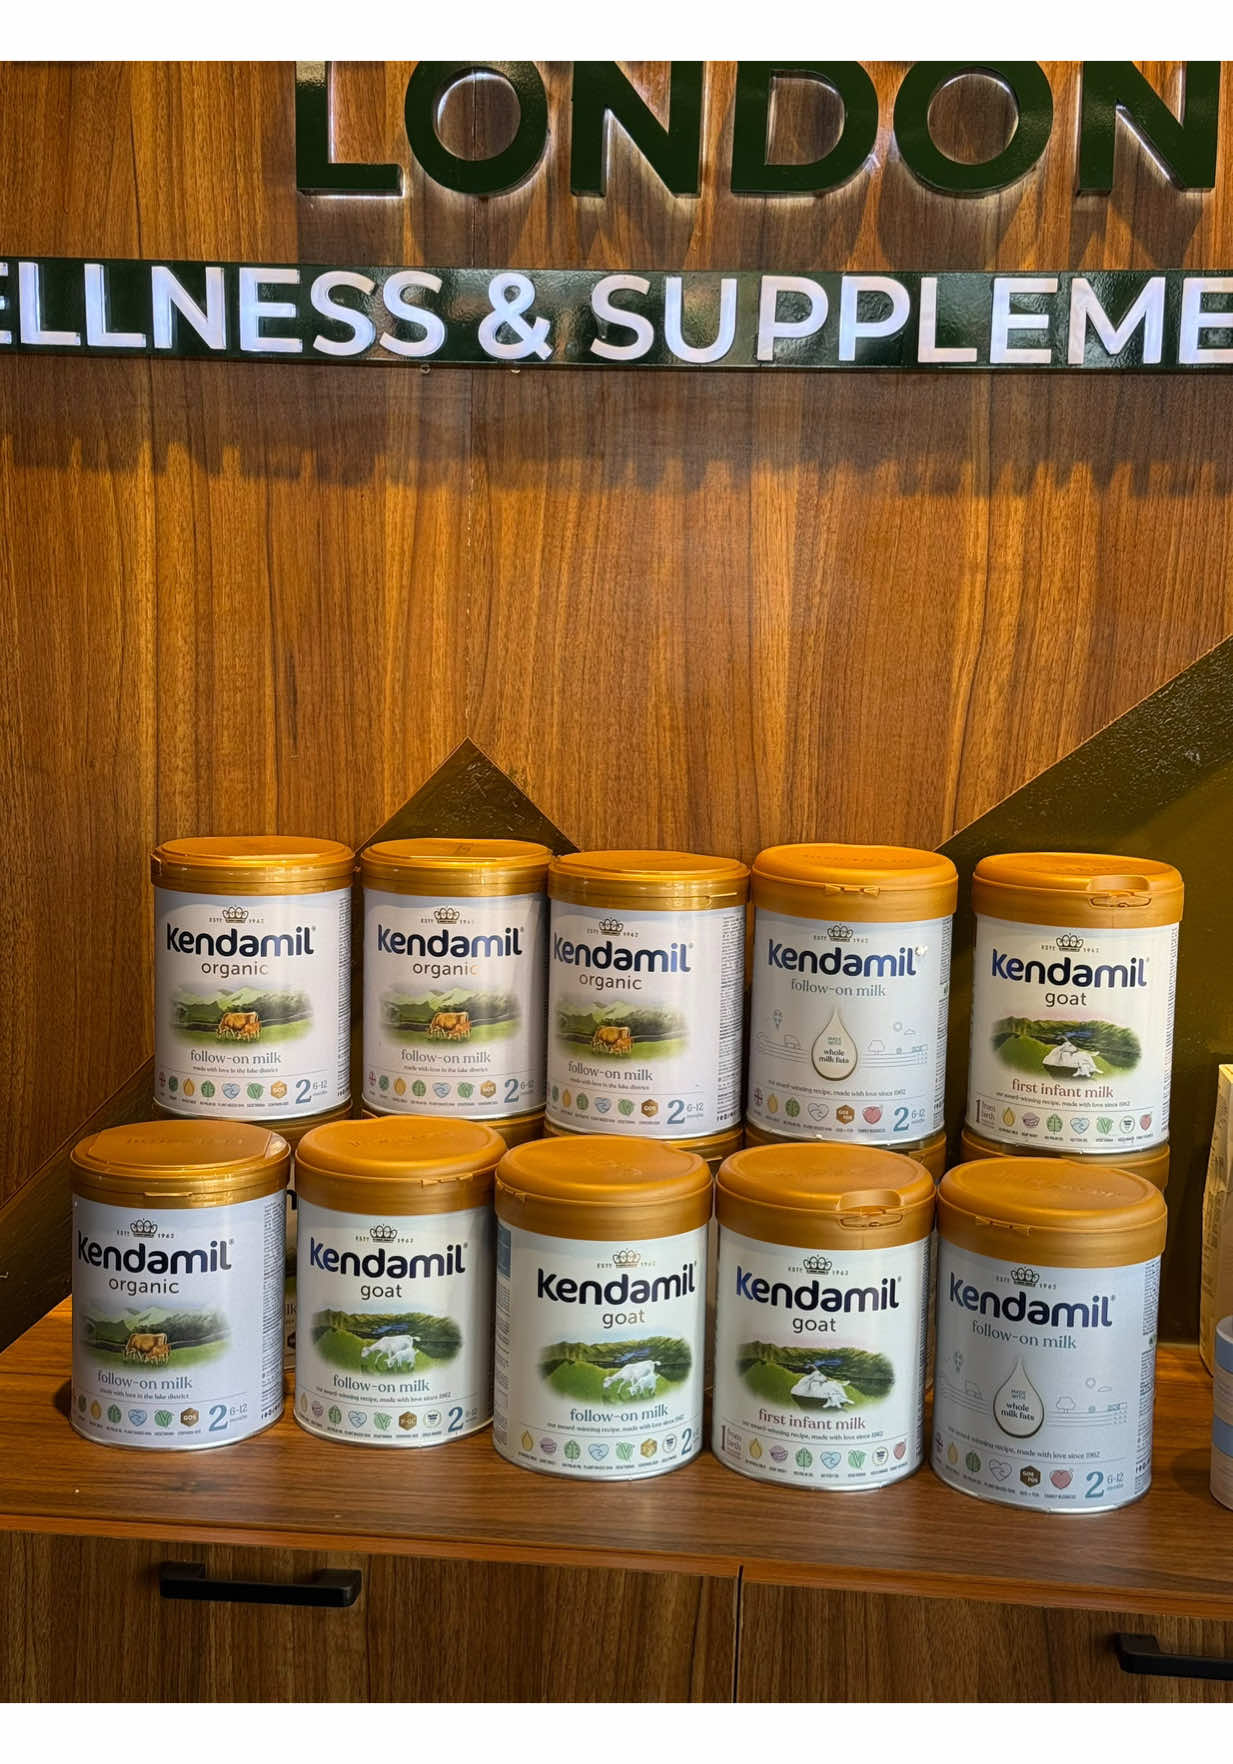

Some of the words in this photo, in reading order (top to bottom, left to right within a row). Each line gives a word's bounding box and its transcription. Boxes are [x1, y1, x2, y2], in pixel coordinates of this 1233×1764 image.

[295, 61, 1222, 196] LONDON
[0, 260, 445, 357] LLNESS
[478, 272, 553, 361] &
[201, 961, 269, 979] organic
[412, 961, 479, 979] organic
[579, 974, 643, 991] organic
[791, 978, 852, 996] follow-on
[856, 984, 886, 997] milk
[1045, 992, 1087, 1007] goat
[191, 1049, 249, 1064] follow-on
[252, 1050, 281, 1064] milk
[401, 1049, 460, 1064] follow-on
[463, 1051, 490, 1063] milk
[824, 1048, 845, 1056] whole
[568, 1062, 621, 1080] follow-on
[624, 1069, 653, 1082] milk
[295, 1079, 312, 1104] 2
[504, 1078, 520, 1103] 2
[1011, 1079, 1037, 1093] first
[1041, 1083, 1081, 1098] infant
[1084, 1086, 1114, 1098] milk
[667, 1099, 685, 1125] 2
[893, 1107, 909, 1132] 2
[108, 1278, 179, 1297] organic
[360, 1284, 402, 1301] goat
[602, 1310, 645, 1328] goat
[792, 1317, 836, 1334] goat
[972, 1320, 1039, 1347] follow-on
[1043, 1335, 1077, 1349] milk
[98, 1370, 157, 1390] follow-on
[161, 1376, 193, 1390] milk
[333, 1375, 396, 1393] follow-on
[400, 1379, 430, 1393] milk
[570, 1408, 638, 1422] follow-on
[641, 1404, 668, 1420] milk
[1001, 1409, 1018, 1418] milk
[1006, 1402, 1030, 1412] whole
[208, 1404, 228, 1432] 2
[447, 1406, 463, 1433] 2
[759, 1408, 785, 1426] first
[789, 1415, 832, 1430] infant
[835, 1416, 865, 1430] milk
[681, 1428, 692, 1456] 2
[1085, 1471, 1105, 1498] 2
